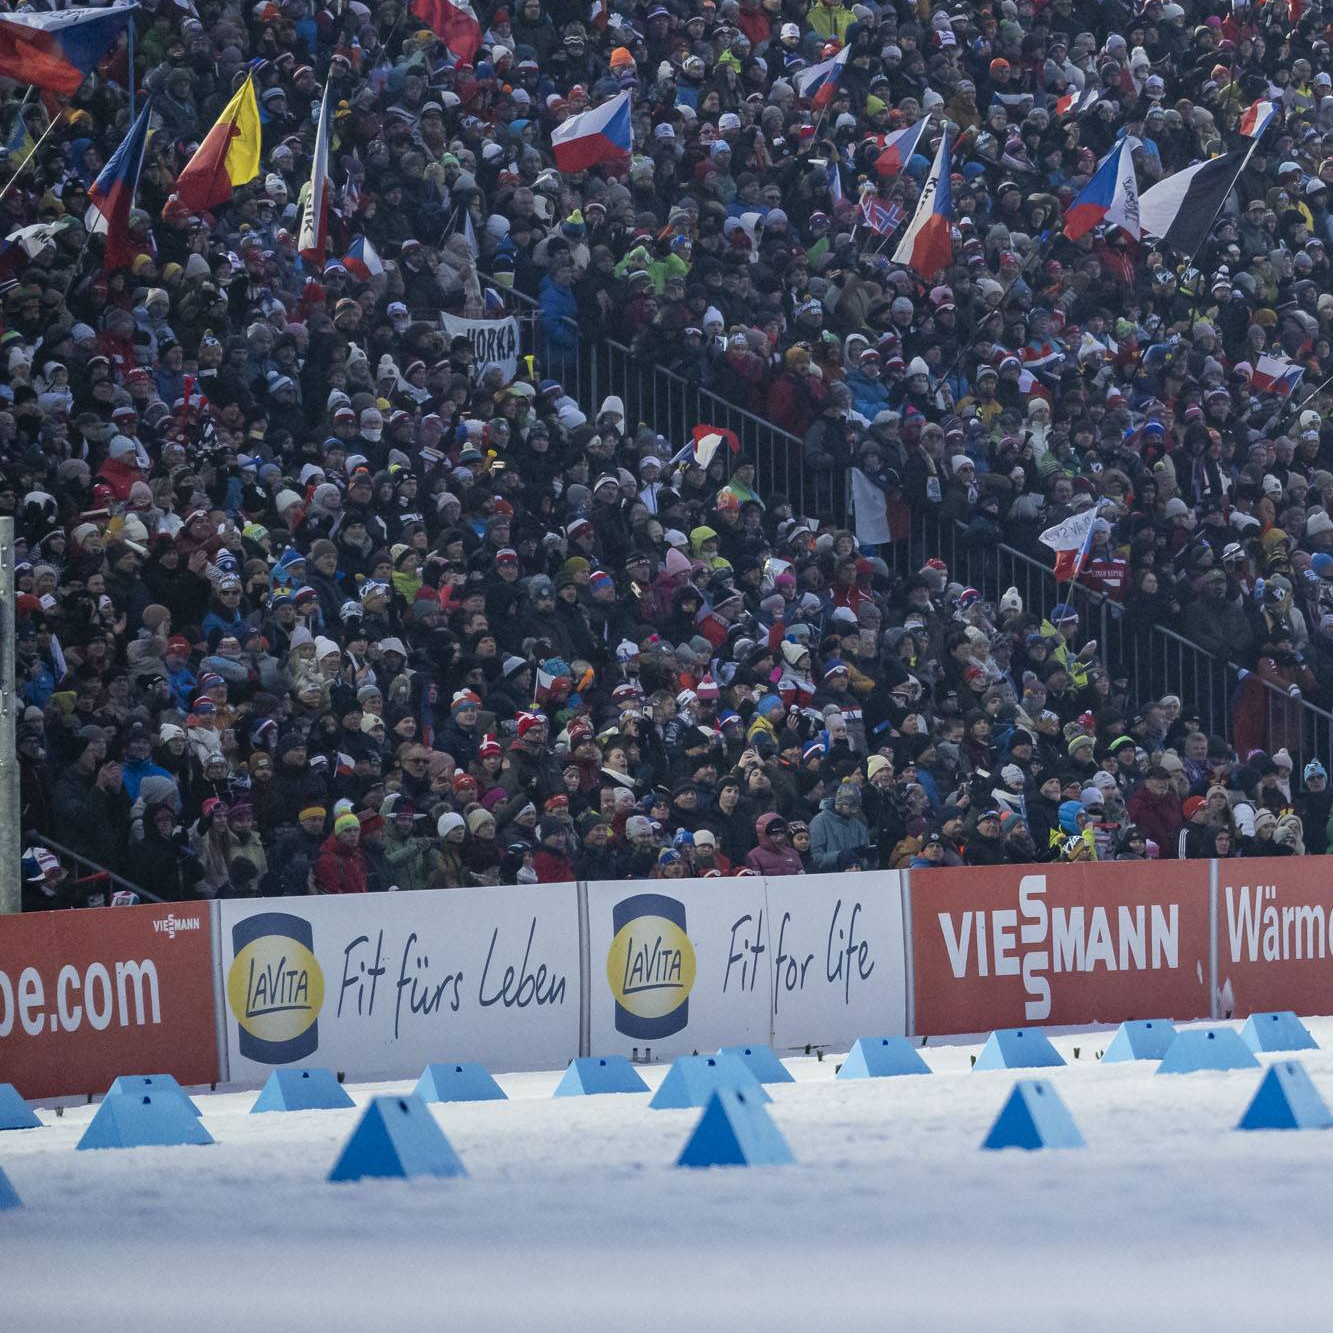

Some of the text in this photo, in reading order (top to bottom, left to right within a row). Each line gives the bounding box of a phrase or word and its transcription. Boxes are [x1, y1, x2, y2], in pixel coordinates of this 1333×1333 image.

[152, 913, 200, 939] VIESSMANN
[337, 917, 567, 1039] Fit fürs Leben
[723, 899, 875, 1015] Fit for life
[937, 874, 1180, 1021] VIESSMANN
